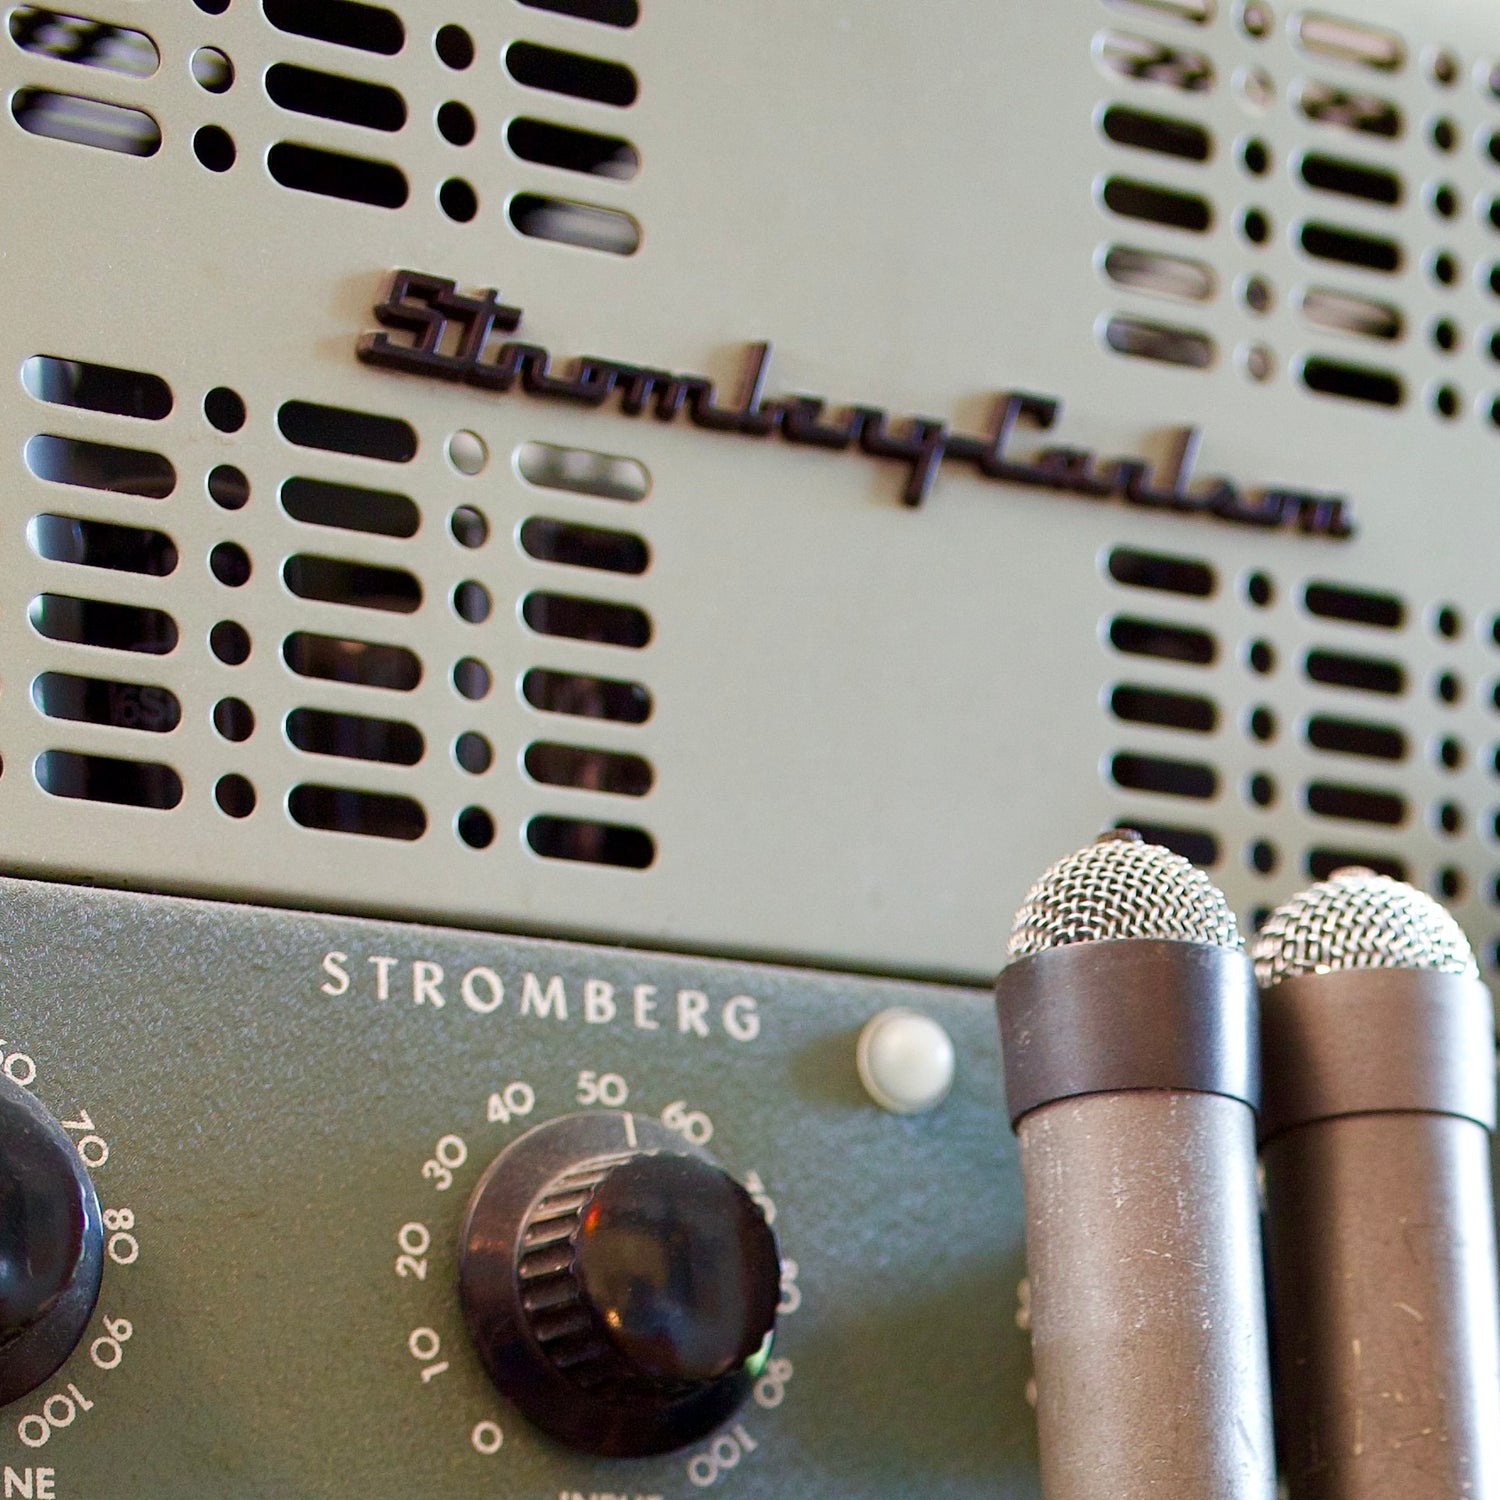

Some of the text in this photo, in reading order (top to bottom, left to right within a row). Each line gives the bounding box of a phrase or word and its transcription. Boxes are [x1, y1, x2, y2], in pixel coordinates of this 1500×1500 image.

[321, 950, 762, 1043] STROMBERG
[487, 1081, 536, 1126] 40
[576, 1070, 628, 1107] 50
[62, 1109, 110, 1169] 70
[660, 1100, 714, 1146] 60
[422, 1133, 468, 1192] 30
[103, 1207, 139, 1265] 80
[397, 1222, 430, 1280] 20
[90, 1314, 133, 1370] 90
[408, 1327, 449, 1383] 10
[18, 1383, 94, 1448] 100
[471, 1421, 504, 1455] 0
[3, 1465, 56, 1500] NE
[687, 1424, 758, 1488] 100
